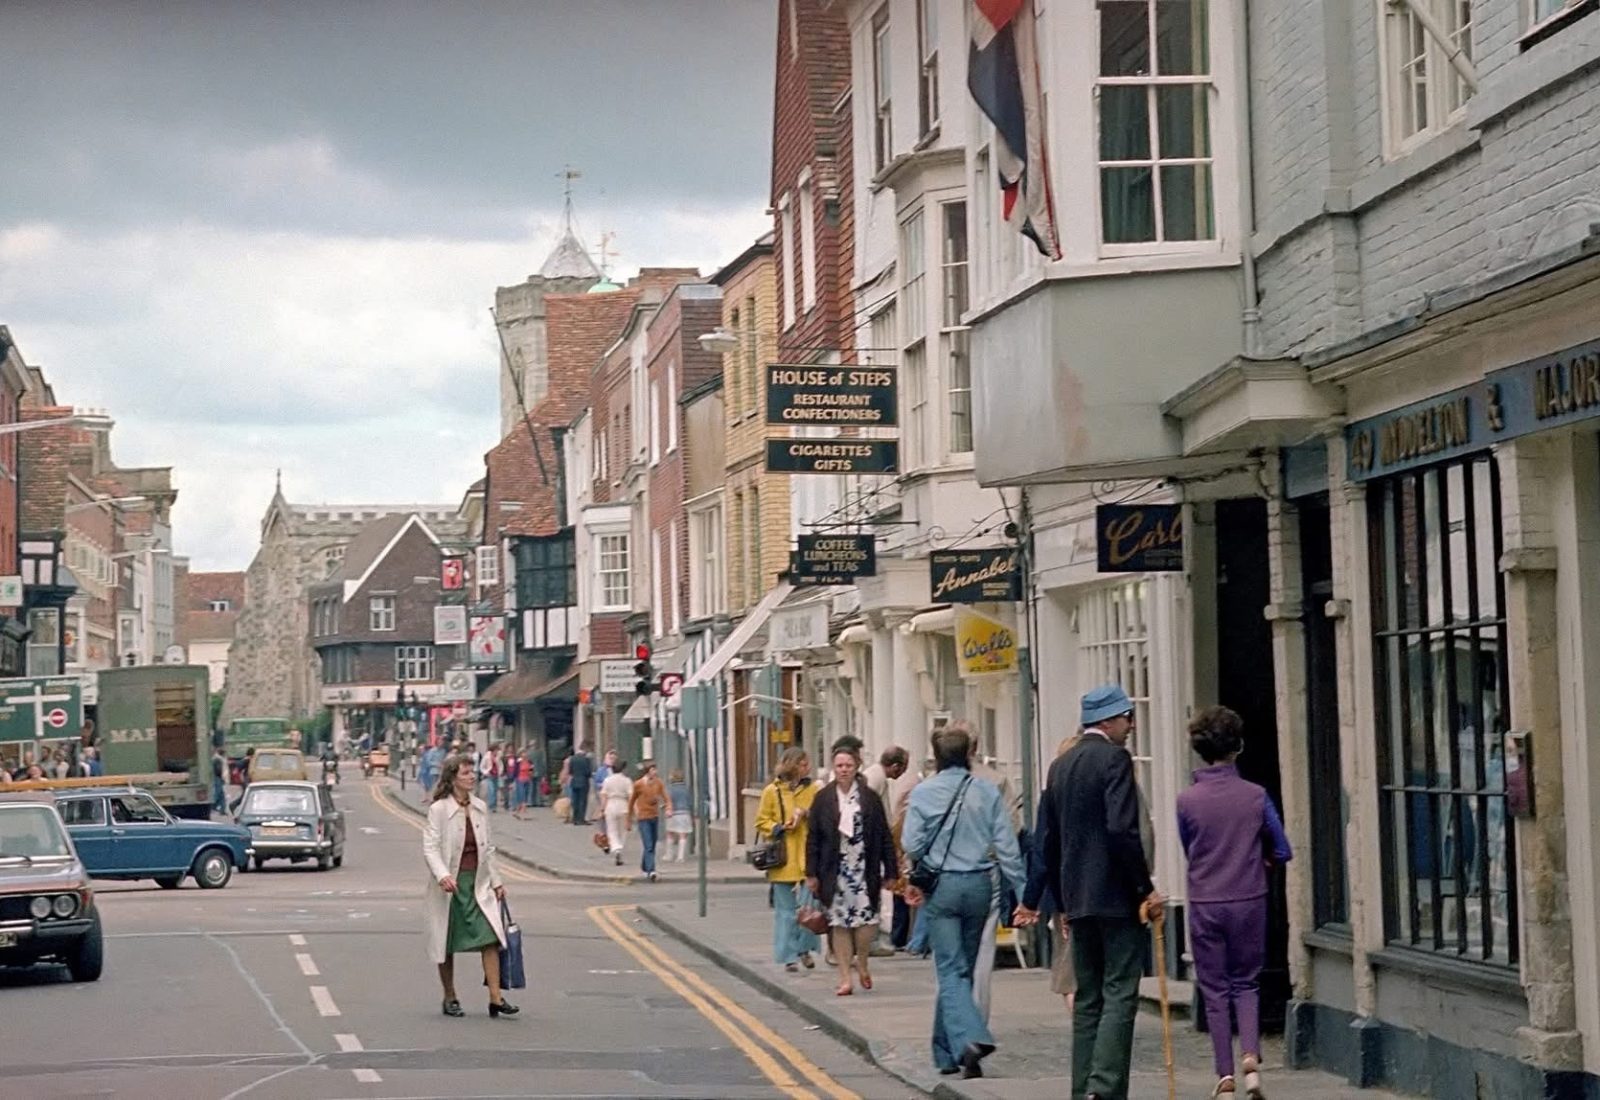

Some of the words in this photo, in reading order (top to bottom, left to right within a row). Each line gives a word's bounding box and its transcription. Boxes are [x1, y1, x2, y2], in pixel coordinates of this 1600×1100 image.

[772, 370, 827, 385] HOUSE
[829, 371, 845, 386] of
[849, 371, 892, 386] STEPS
[793, 394, 872, 406] RESTAURANT
[782, 408, 881, 420] CONFECTIONERS
[789, 445, 872, 457] CIGARETTES
[814, 459, 852, 470] GIFTS
[815, 539, 857, 550] COFFEE
[804, 550, 868, 561] LUNCHEONS
[812, 562, 830, 572] and
[832, 561, 859, 572] TEAS
